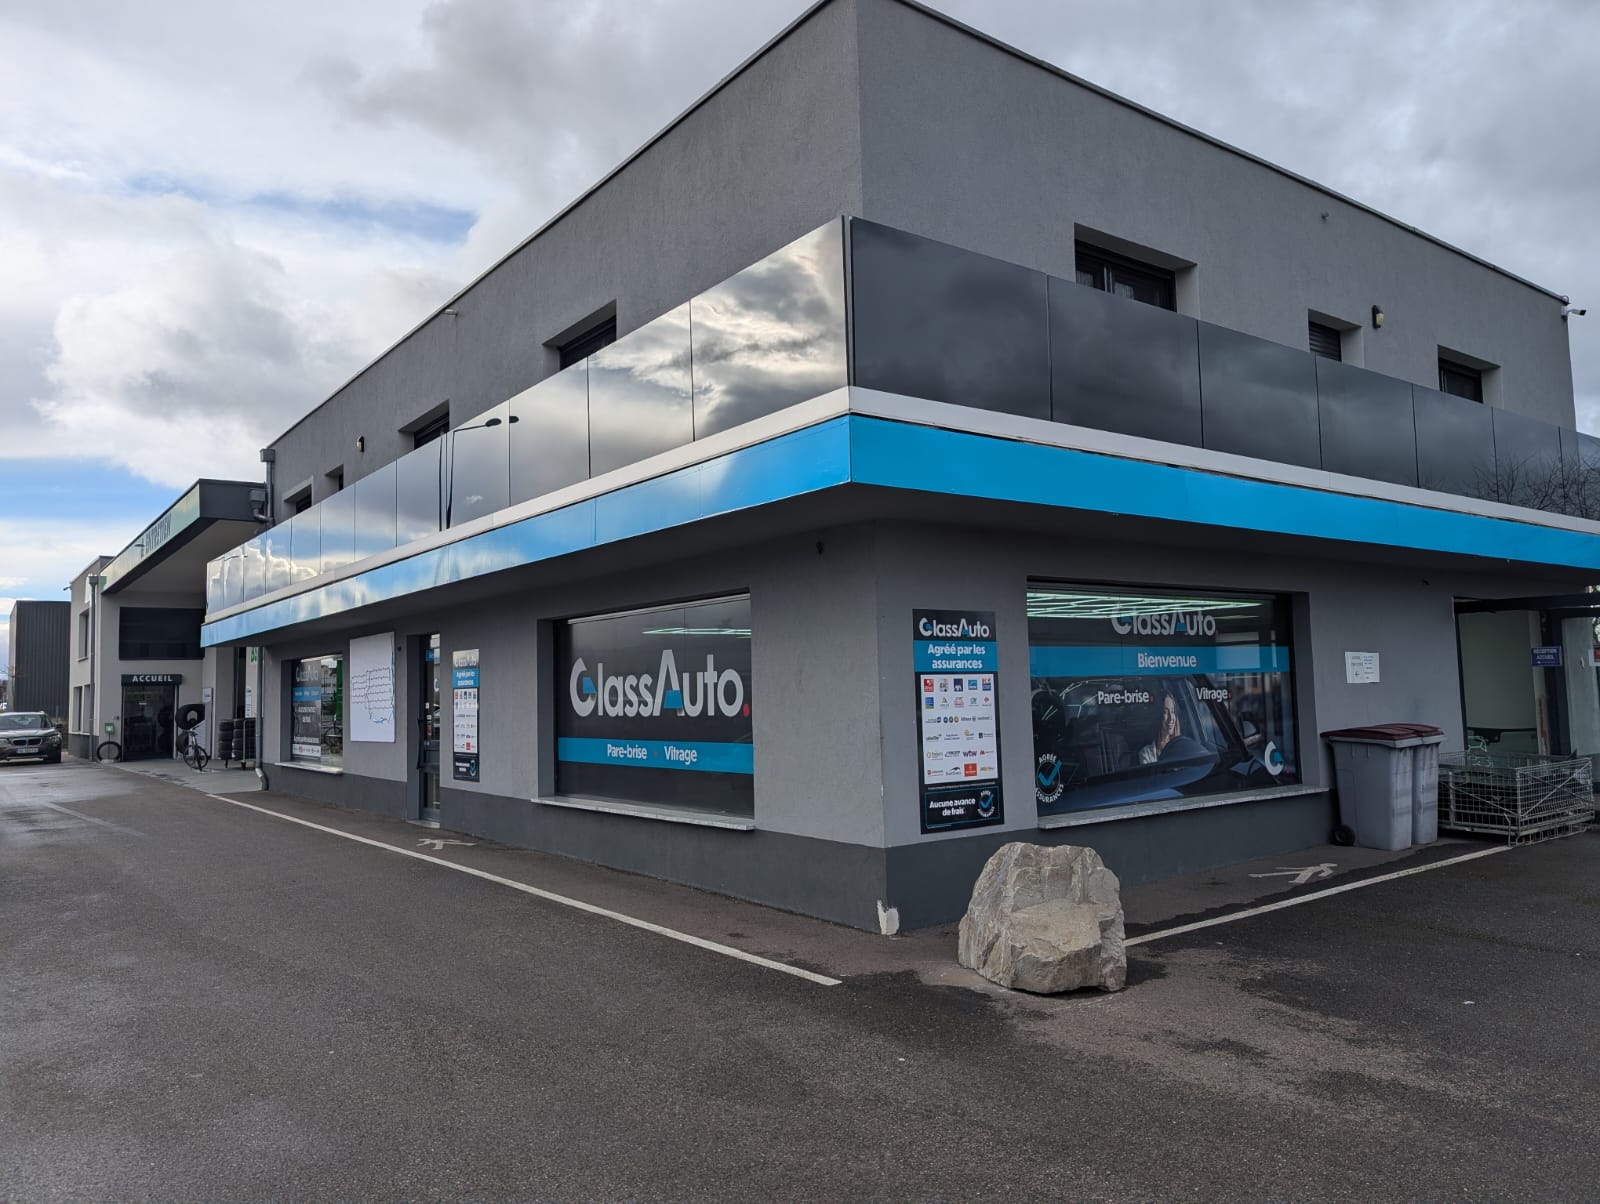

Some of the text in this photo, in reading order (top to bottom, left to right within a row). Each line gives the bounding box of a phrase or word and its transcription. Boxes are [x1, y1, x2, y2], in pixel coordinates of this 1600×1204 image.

[928, 643, 986, 656] Agréé par les
[932, 659, 983, 669] assurances
[607, 743, 698, 765] Pare-brise Vitrage
[929, 798, 976, 809] Aucune avance
